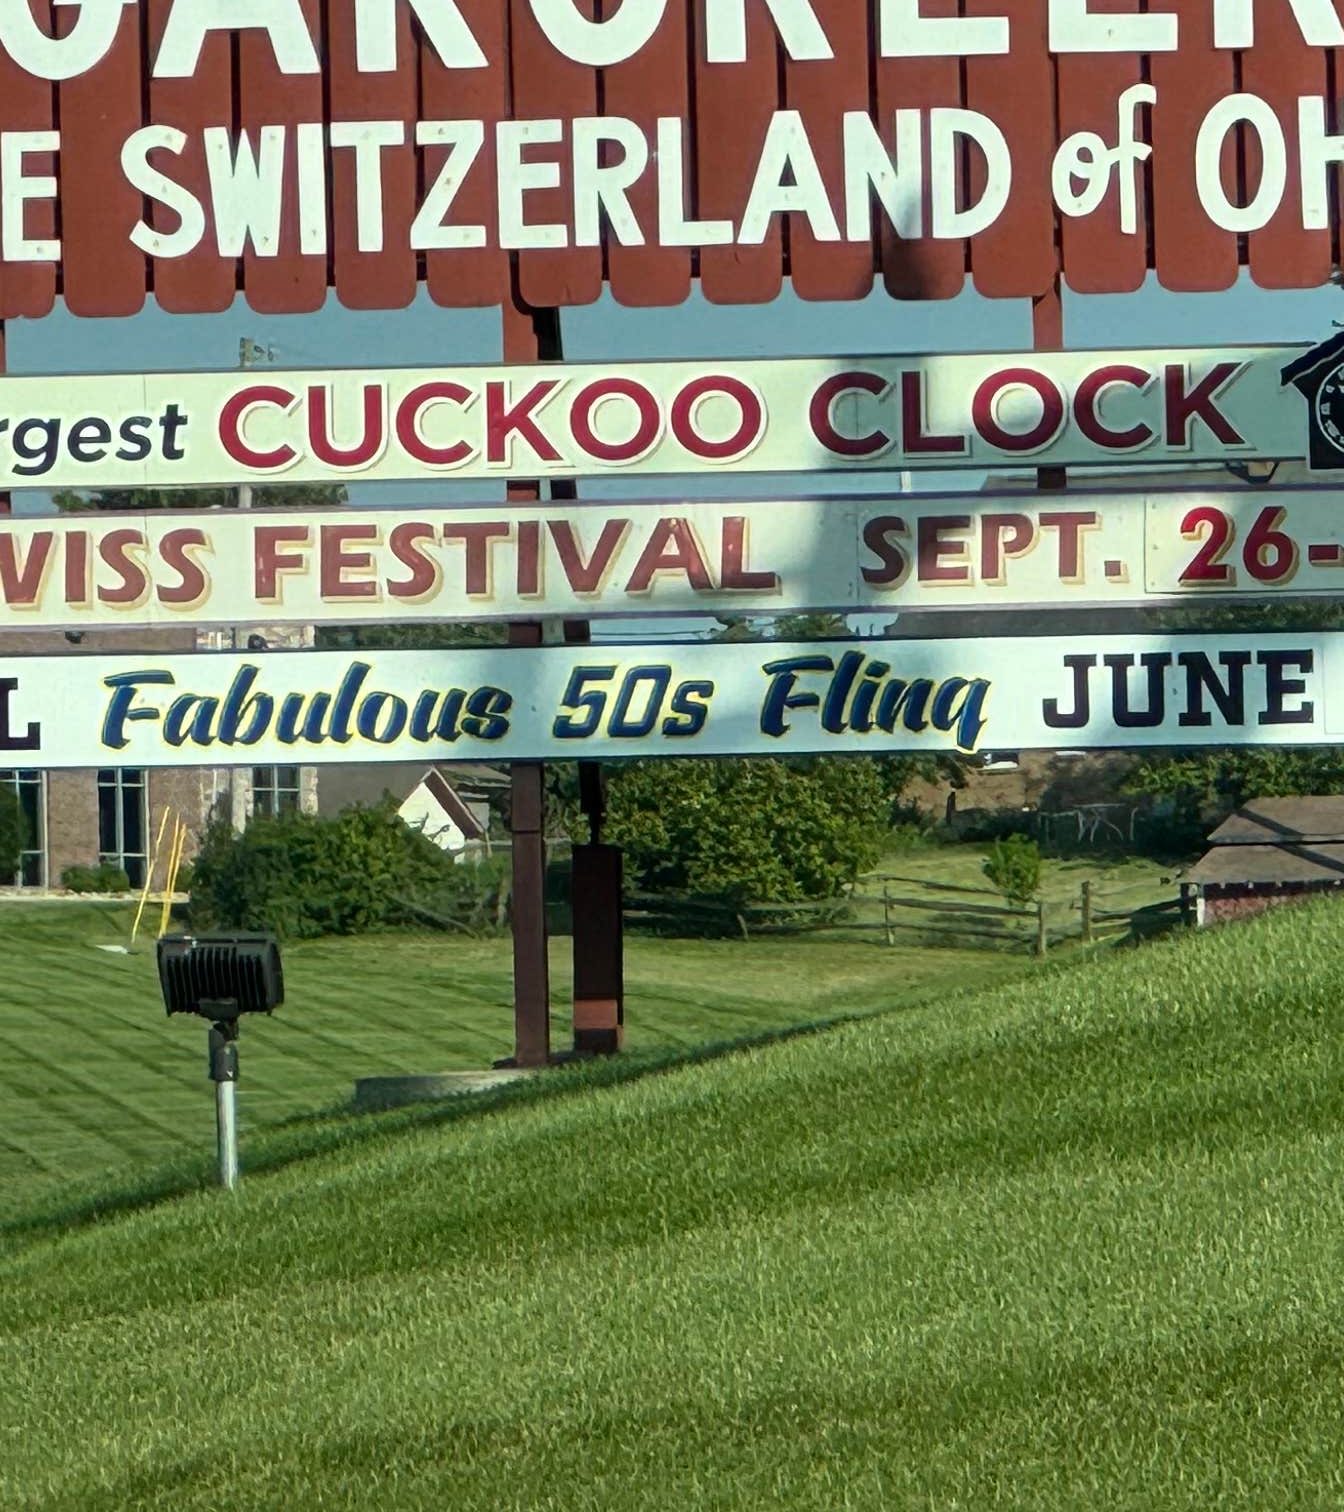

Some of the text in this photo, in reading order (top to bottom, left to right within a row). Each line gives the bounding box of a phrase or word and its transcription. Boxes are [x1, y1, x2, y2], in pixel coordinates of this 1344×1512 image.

[120, 106, 1011, 258] SWITZERLAND
[1051, 83, 1157, 235] of
[218, 375, 763, 468] CUCKOO
[808, 362, 1249, 457] CLOCK
[254, 515, 782, 605] FESTIVAL
[860, 511, 1129, 589] SEPT.
[100, 662, 515, 750] Fabulous
[550, 662, 715, 740] 50s
[1041, 648, 1315, 728] JUNE
